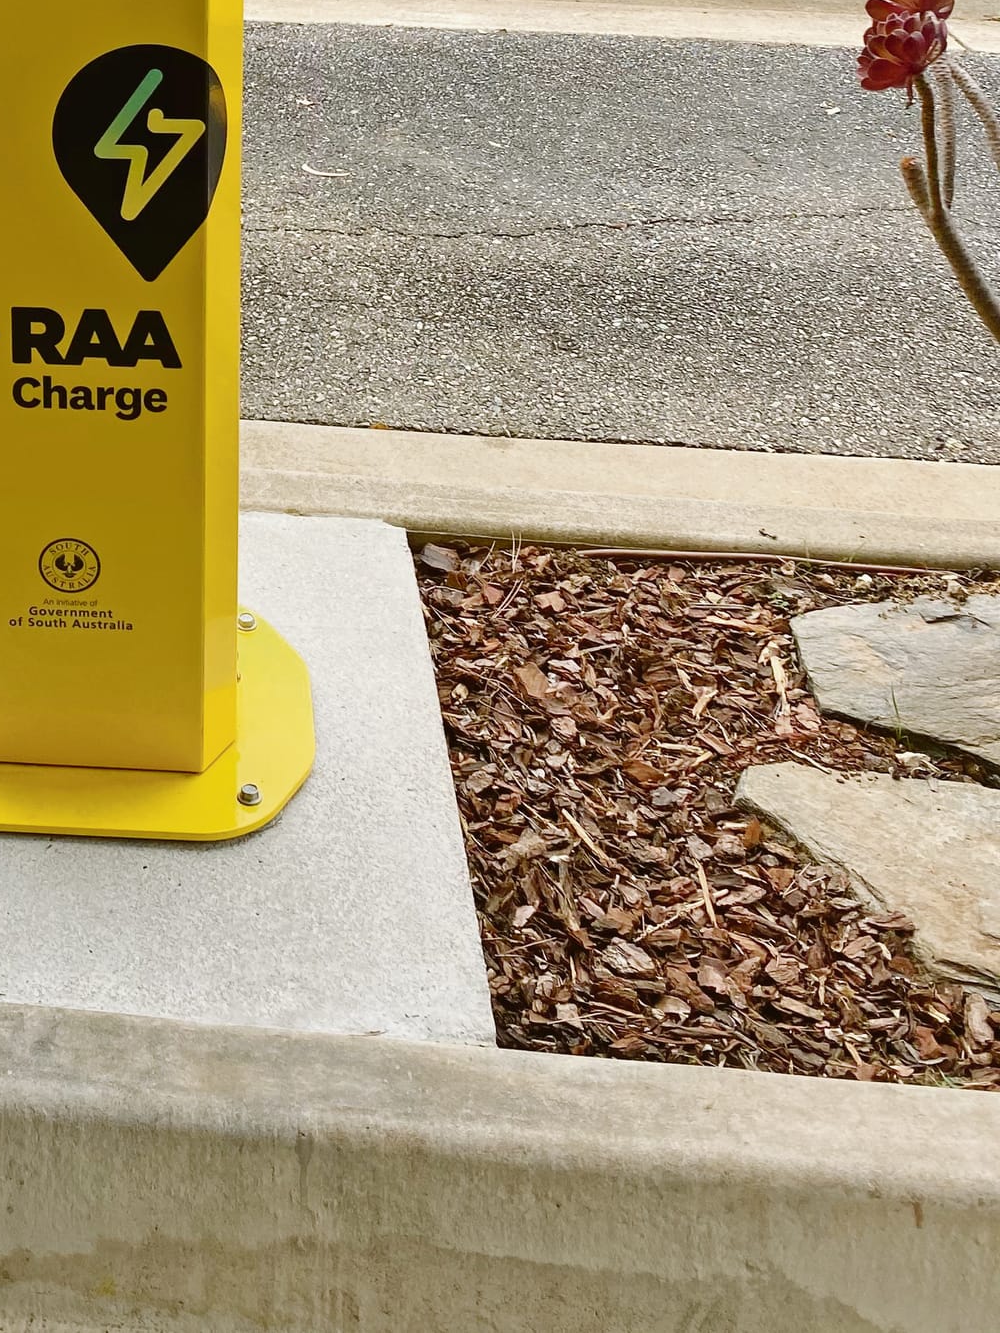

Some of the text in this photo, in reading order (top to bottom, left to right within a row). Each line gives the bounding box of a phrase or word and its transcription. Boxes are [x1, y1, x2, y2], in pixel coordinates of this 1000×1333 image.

[11, 306, 183, 369] RAA
[12, 375, 168, 421] Charge
[49, 542, 90, 556] SOUTH
[43, 564, 97, 589] AUSTRALIA
[89, 599, 98, 607] of
[29, 606, 113, 618] Government
[9, 616, 133, 631] of South Australia
